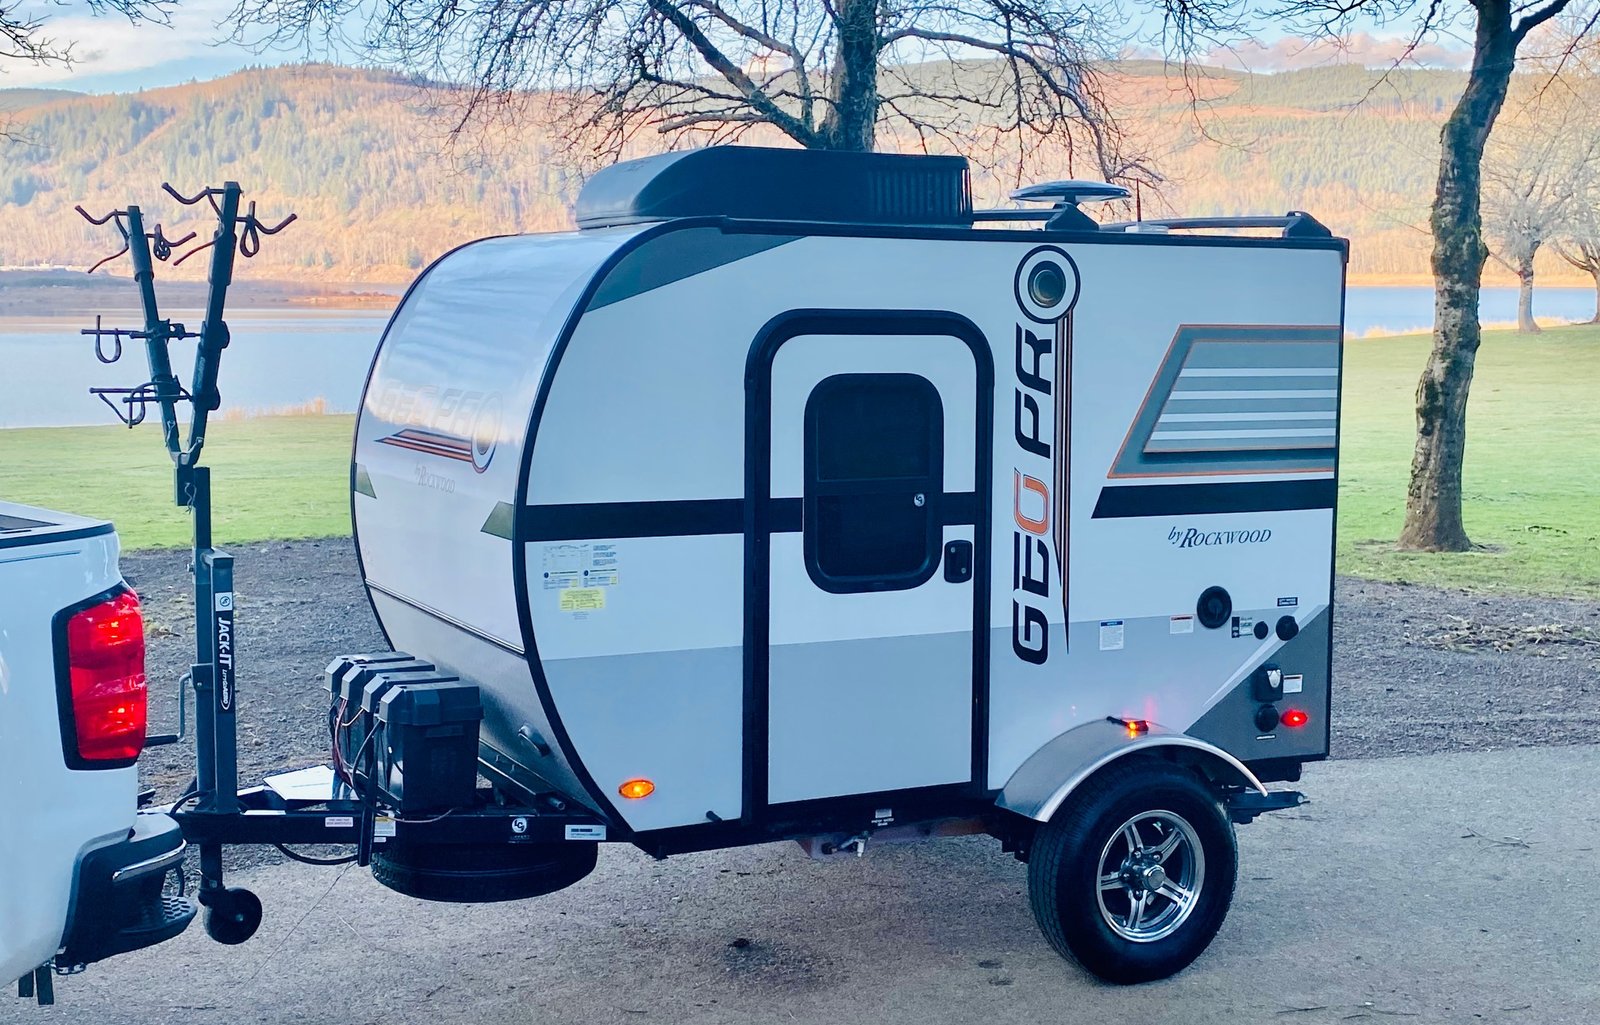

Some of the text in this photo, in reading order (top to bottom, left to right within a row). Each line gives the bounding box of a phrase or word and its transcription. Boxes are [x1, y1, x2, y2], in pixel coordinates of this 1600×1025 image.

[1012, 245, 1081, 665] GEO PRO
[1167, 526, 1272, 549] by ROCKWOOD
[218, 617, 232, 670] JACK-IT
